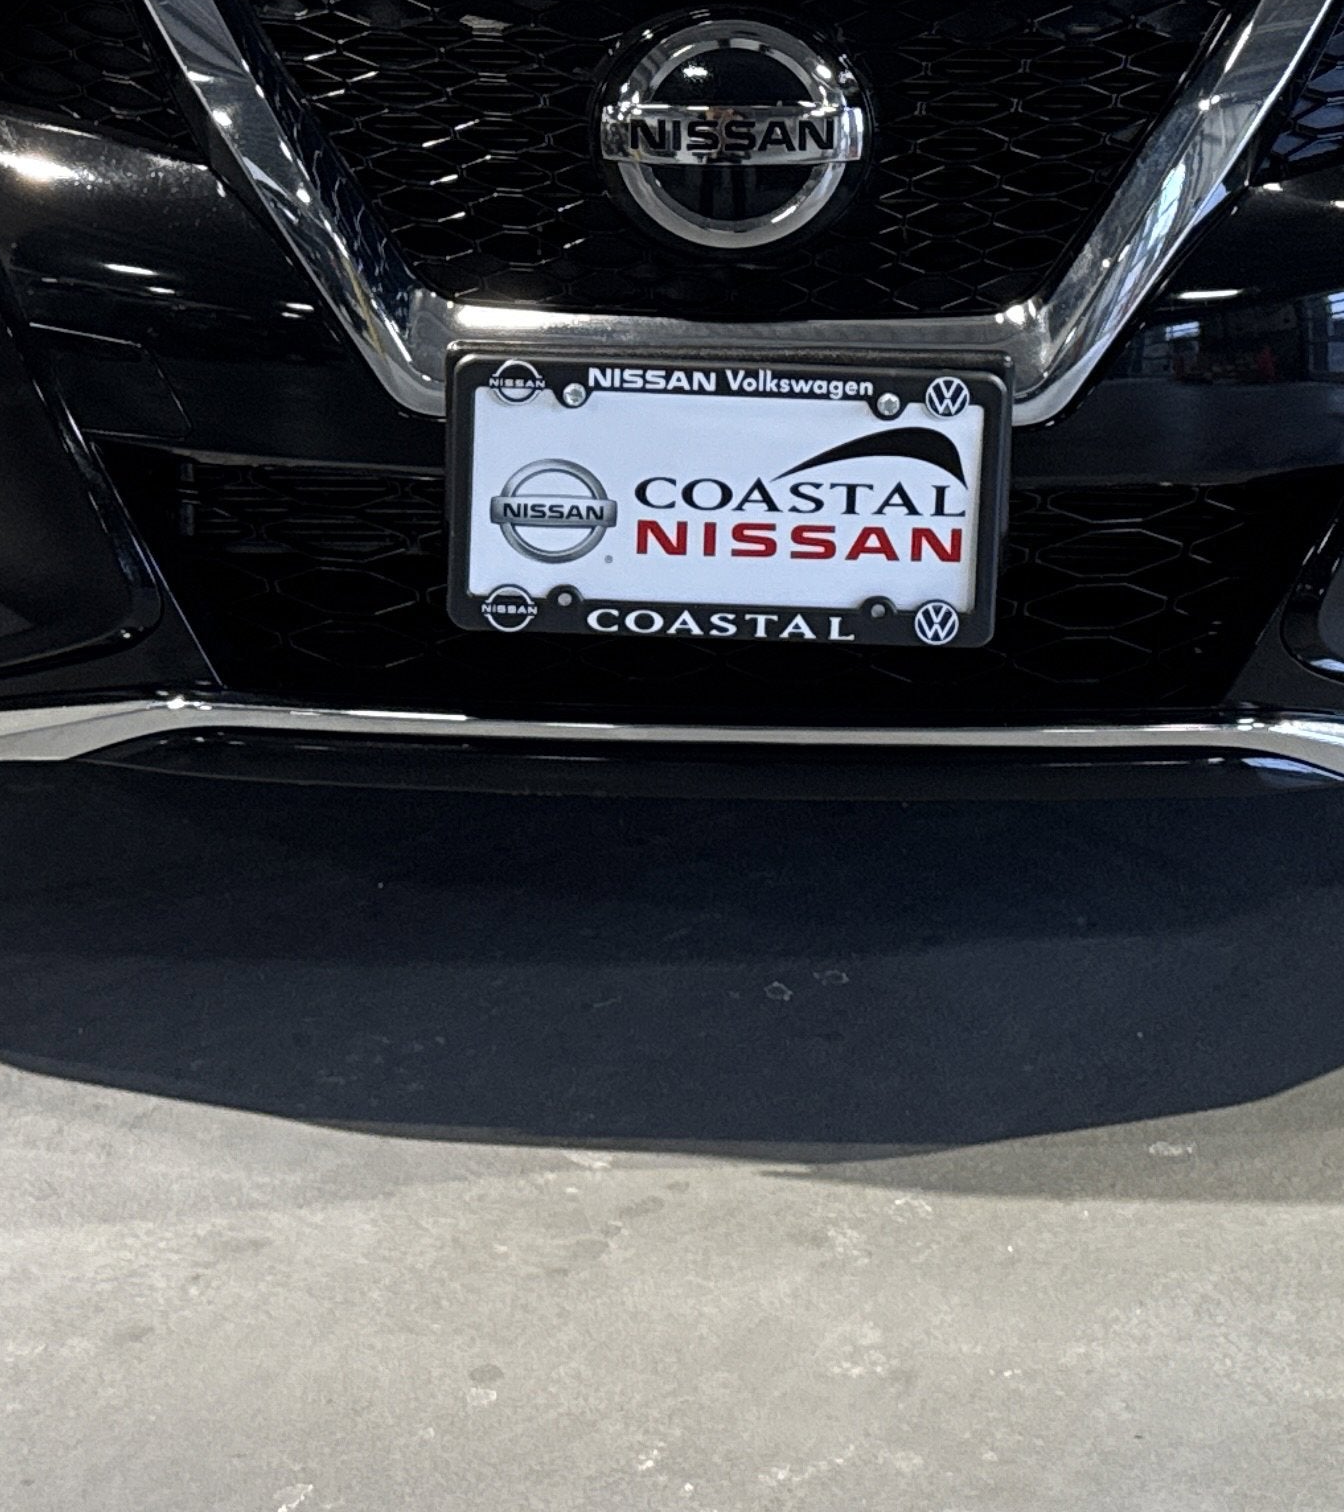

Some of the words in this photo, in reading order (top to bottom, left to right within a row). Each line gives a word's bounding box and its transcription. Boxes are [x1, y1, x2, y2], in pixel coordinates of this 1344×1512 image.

[629, 118, 834, 152] NISSAN
[488, 376, 546, 389] NISSAN
[588, 367, 717, 392] NISSAN
[725, 368, 874, 400] Volkswagen
[503, 501, 605, 522] NISSAN
[634, 476, 967, 518] COASTAL
[636, 519, 963, 563] NISSAN
[481, 603, 538, 615] NISSAN
[586, 608, 855, 641] COASTAL
